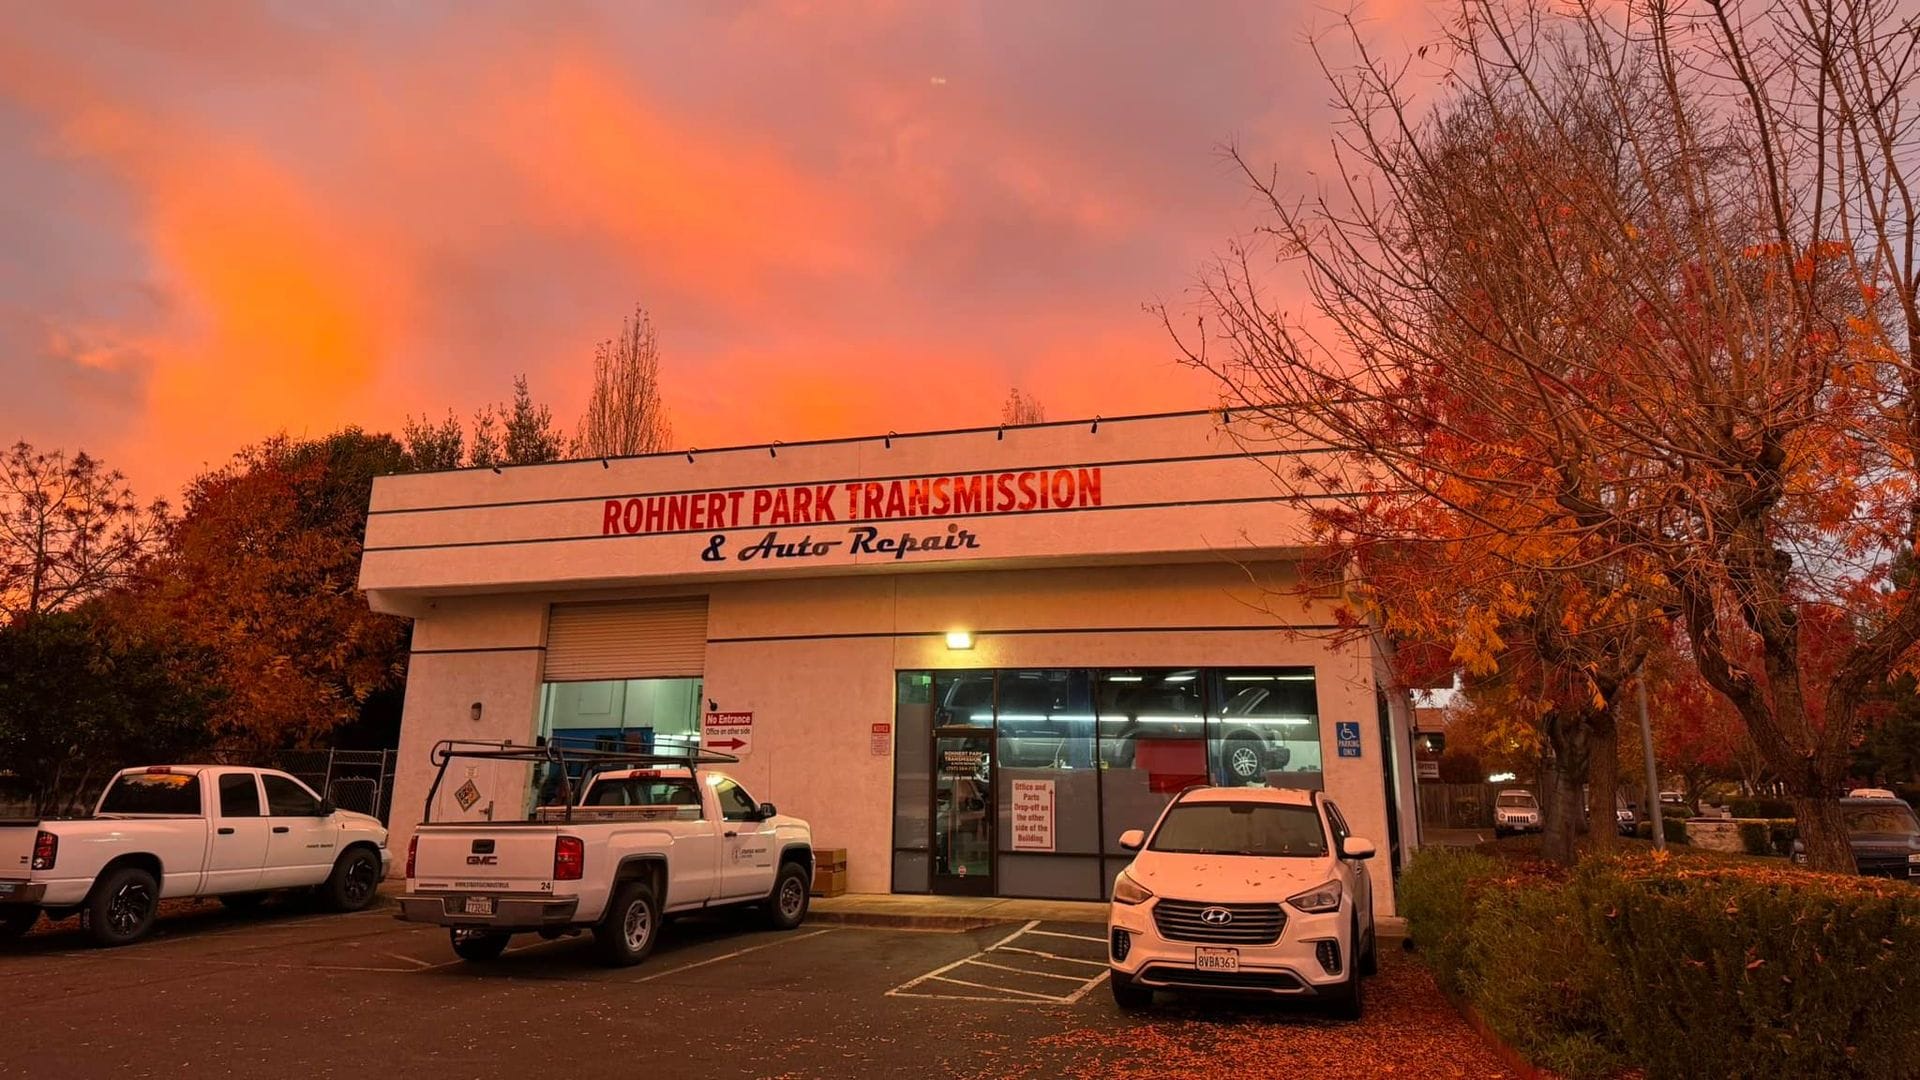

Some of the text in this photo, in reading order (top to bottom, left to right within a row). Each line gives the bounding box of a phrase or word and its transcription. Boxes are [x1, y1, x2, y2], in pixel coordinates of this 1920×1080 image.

[602, 467, 1102, 535] ROHNERT PARK TRANSMISSION
[701, 523, 981, 562] & Auto Repair
[706, 714, 751, 725] No Entrance
[1339, 740, 1360, 748] PARKING
[1343, 748, 1357, 756] ONLY
[1015, 783, 1046, 791] Office and
[1023, 793, 1040, 801] Parts
[1014, 803, 1040, 812] Drop-off
[1038, 824, 1048, 832] the
[1017, 834, 1044, 844] Building
[466, 856, 497, 865] GMC
[541, 882, 551, 890] 24
[1198, 955, 1236, 968] 8VBA363
